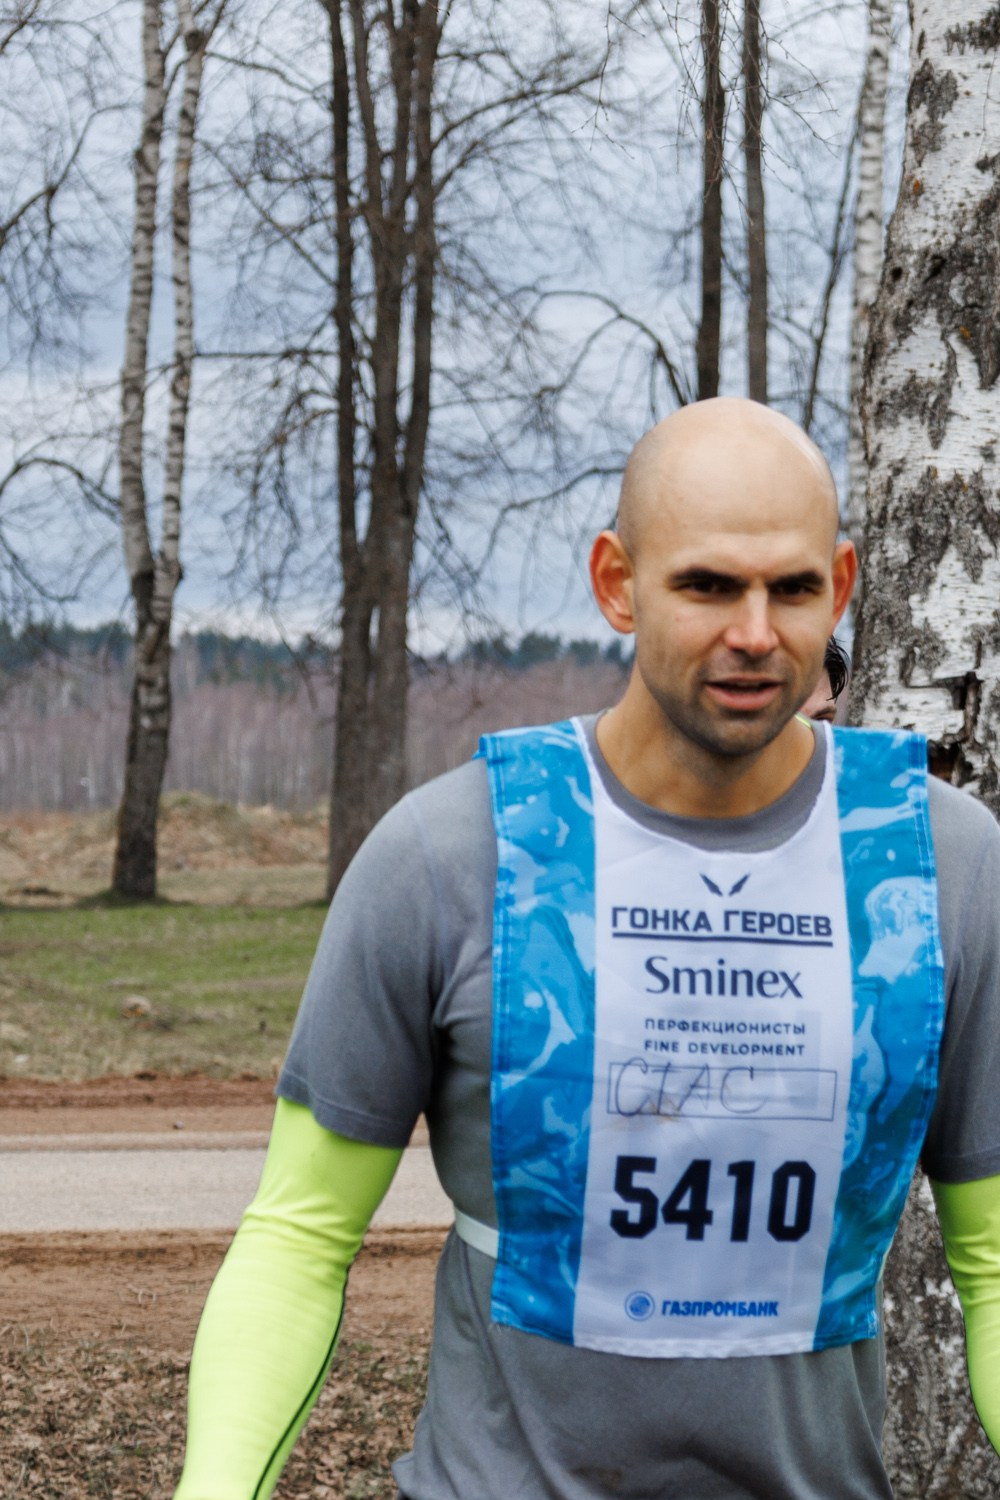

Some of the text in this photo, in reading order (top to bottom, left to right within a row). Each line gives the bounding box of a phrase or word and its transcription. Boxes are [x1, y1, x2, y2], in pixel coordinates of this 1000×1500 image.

[611, 906, 833, 938] ГОНКА ГЕРОЕВ
[645, 956, 803, 999] Sminex
[645, 1018, 806, 1035] ПЕРФЕКЦИОНИСТЫ
[645, 1040, 805, 1056] FINE DEVELOPMENT
[610, 1155, 816, 1242] 5410
[662, 1300, 779, 1317] ГАЗПРОМБАНК
